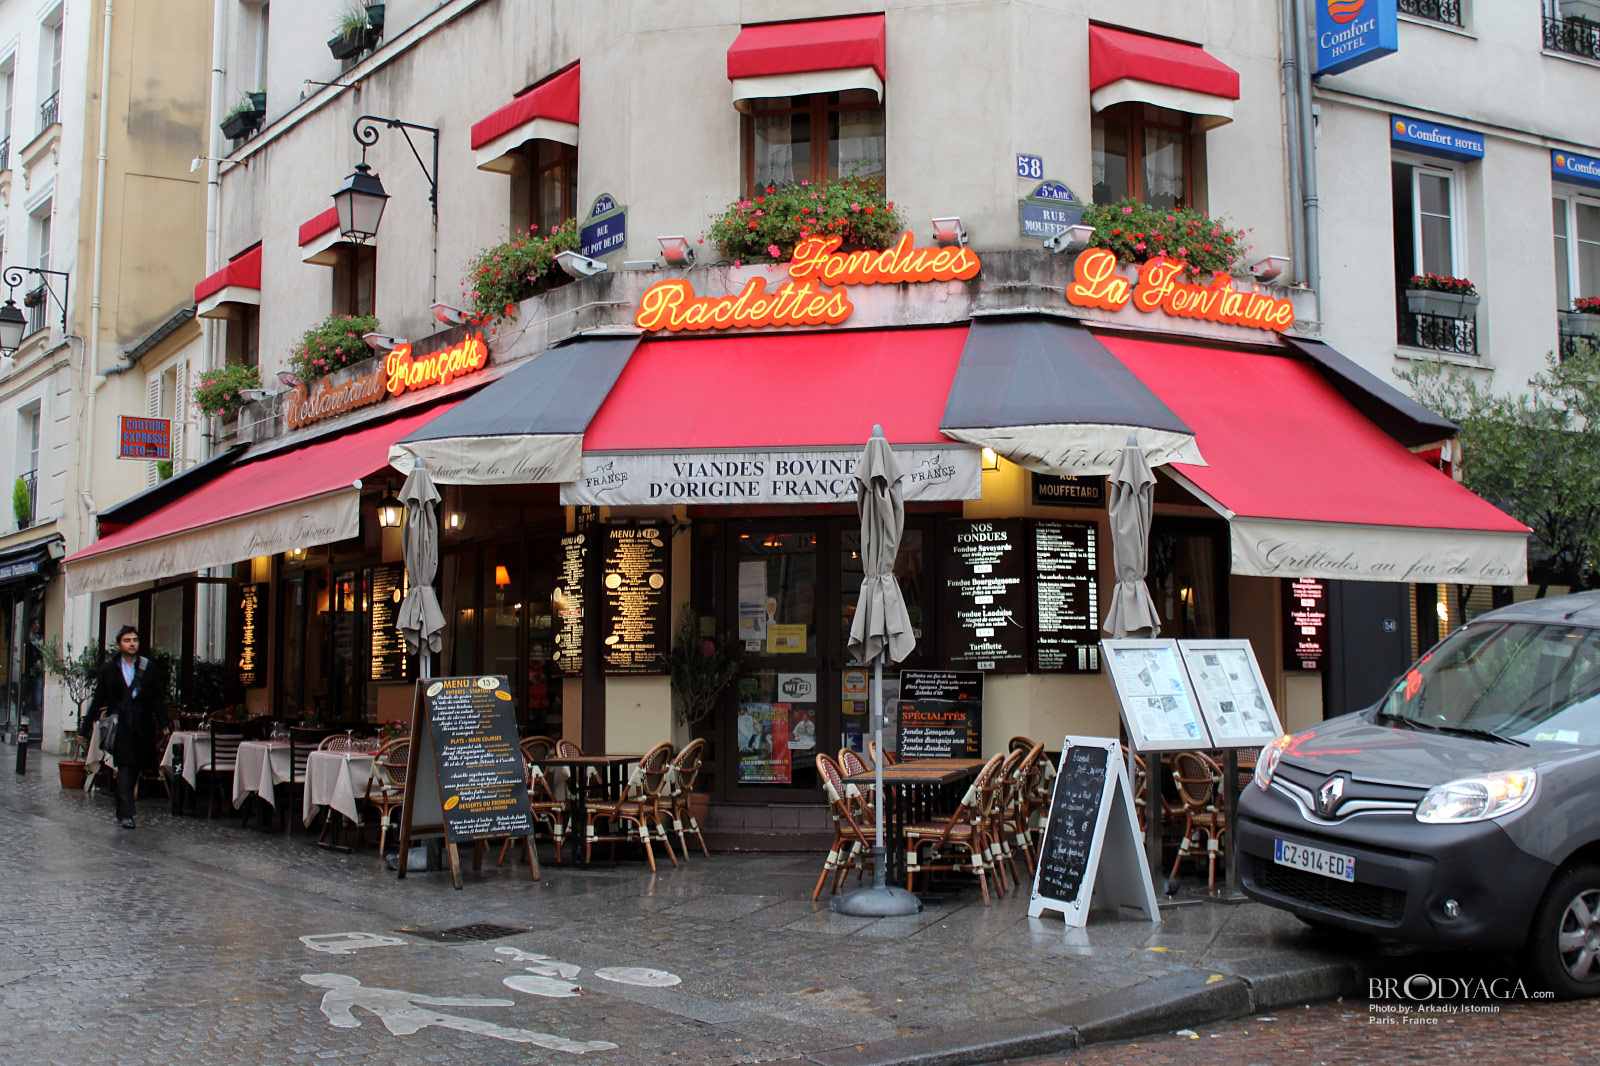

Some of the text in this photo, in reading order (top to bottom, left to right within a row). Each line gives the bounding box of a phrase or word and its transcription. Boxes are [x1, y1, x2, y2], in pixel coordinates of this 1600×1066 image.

[1321, 18, 1376, 49] Comfort
[1332, 36, 1366, 58] HOTEL
[1407, 124, 1483, 152] Comfort HOTEL
[1018, 156, 1041, 178] 58
[1043, 210, 1065, 222] RUE
[597, 224, 608, 238] RUE
[1025, 220, 1069, 233] MOUFFE
[582, 232, 624, 256] DU POT DE FER
[791, 237, 976, 278] Fondues
[1074, 254, 1293, 326] La Fontaine
[637, 281, 847, 327] Raclettes
[283, 333, 482, 426] Restaurant Français
[126, 419, 166, 431] COUTURE
[123, 432, 168, 444] EXPRESSE
[123, 445, 168, 457] RETOHE
[672, 459, 861, 478] VIANDES BOVINE
[909, 464, 957, 483] FRANCE
[585, 471, 629, 488] FRANCE
[649, 479, 858, 499] D'ORIGINE FRANÇA
[1039, 483, 1099, 498] MOUFFETARD
[610, 529, 634, 538] MENU
[971, 523, 993, 533] NOS
[957, 531, 1008, 543] FONDUES
[953, 545, 977, 553] Fondue
[1256, 539, 1512, 581] Grillades au feu de bois
[947, 579, 971, 587] Fondue
[1384, 620, 1396, 631] 56
[443, 679, 470, 689] MENU
[902, 710, 966, 721] SPÉCIALITÉS
[458, 801, 482, 809] DESSERTS
[1283, 845, 1344, 875] CZ-914-ED
